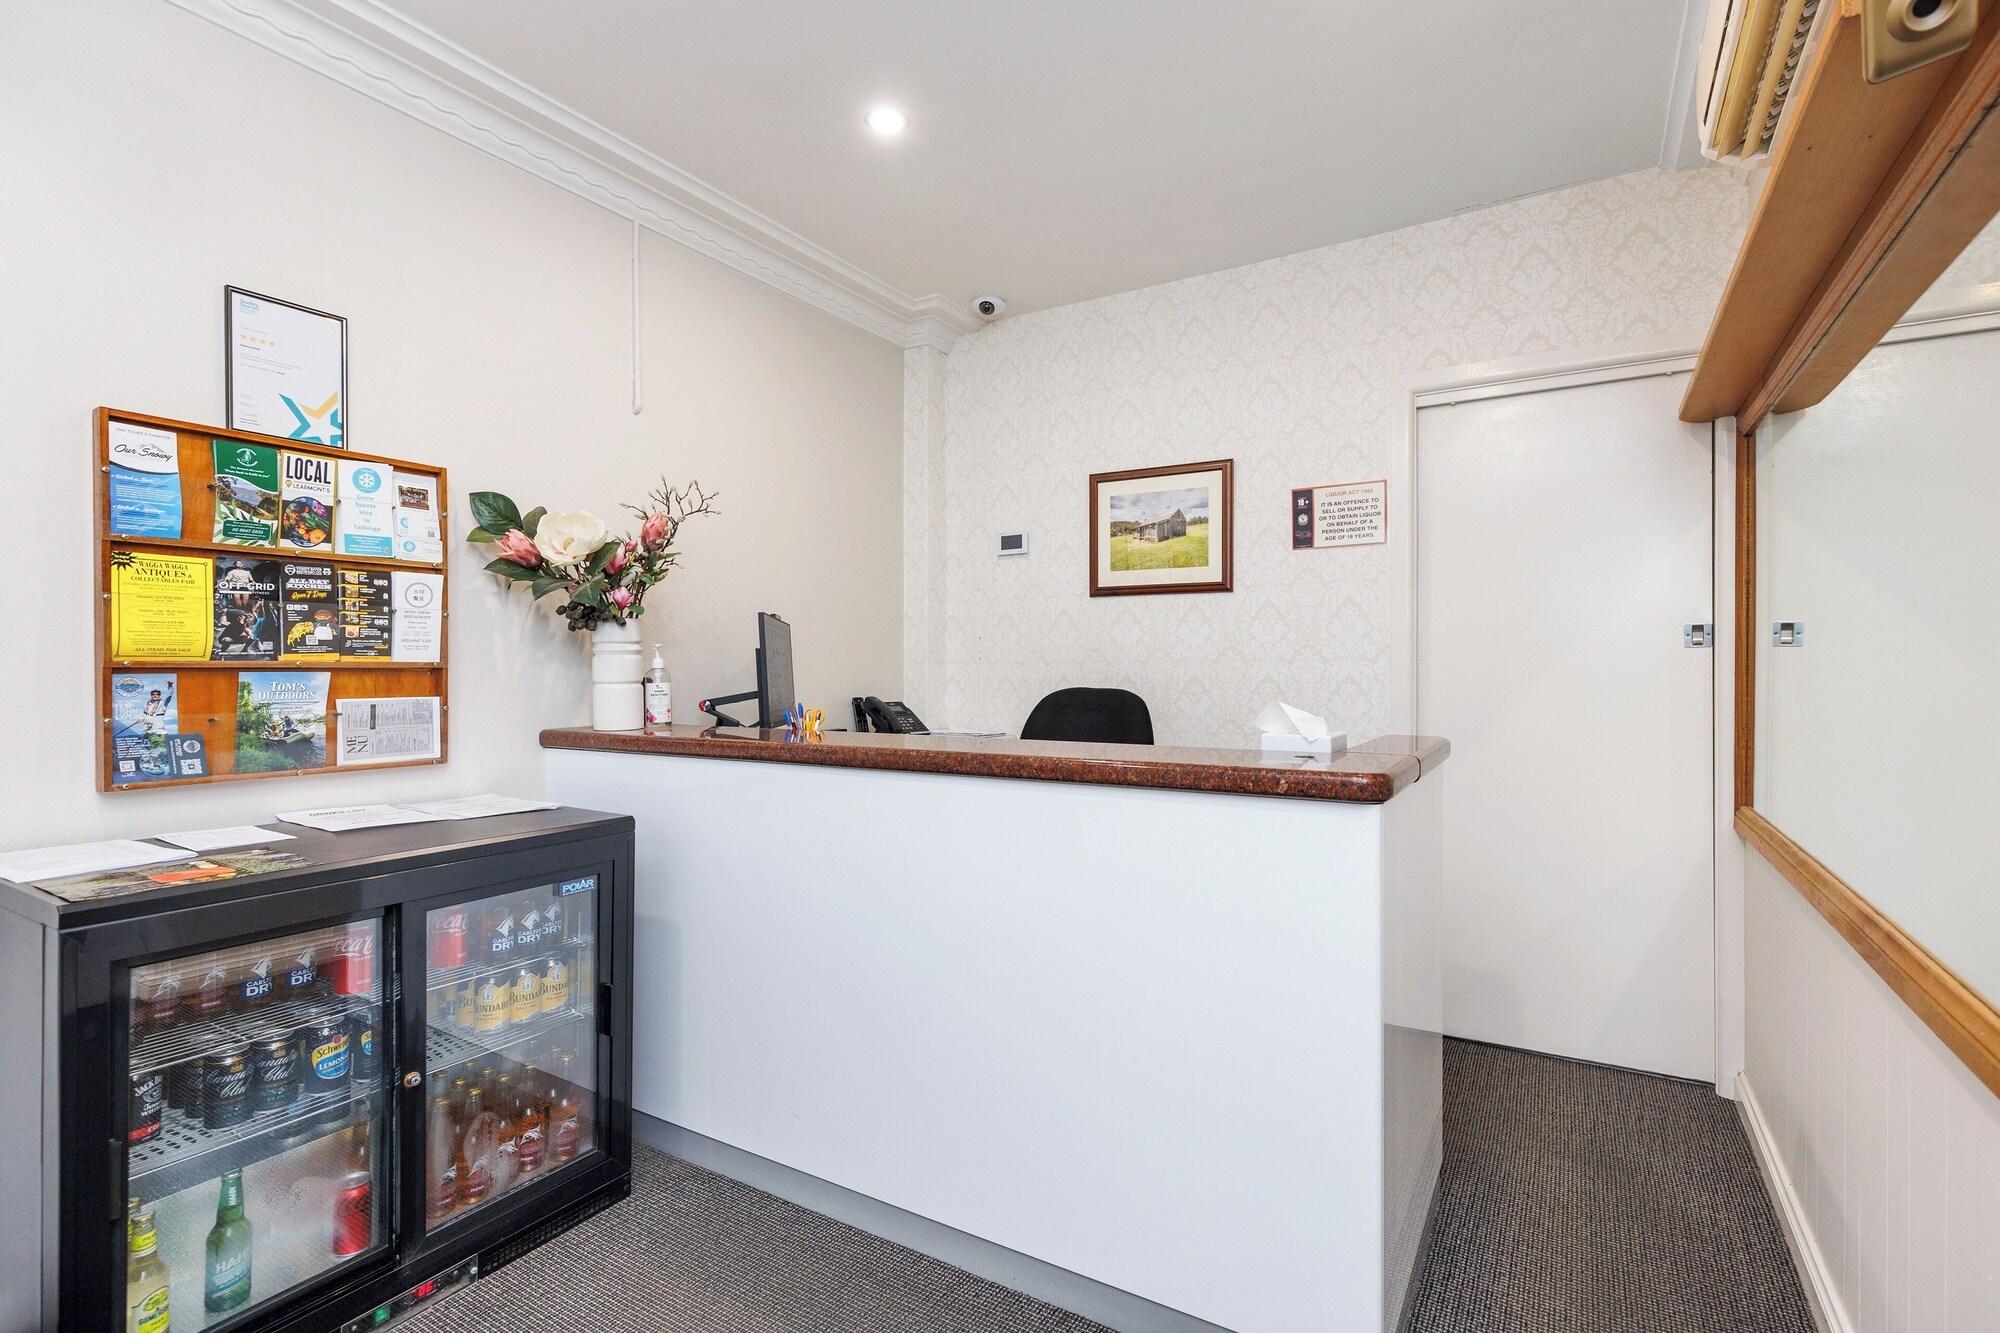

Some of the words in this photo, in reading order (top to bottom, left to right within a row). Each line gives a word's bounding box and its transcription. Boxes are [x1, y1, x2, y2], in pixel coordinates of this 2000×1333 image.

[114, 444, 137, 454] Our
[138, 448, 174, 462] Snowy
[286, 456, 332, 484] LOCAL
[164, 562, 188, 570] WAGGA
[135, 568, 186, 578] ANTIQUES
[270, 681, 306, 692] TOM'S
[258, 691, 316, 700] OUTDOORS
[562, 879, 594, 892] POLAR
[518, 933, 541, 944] DRY
